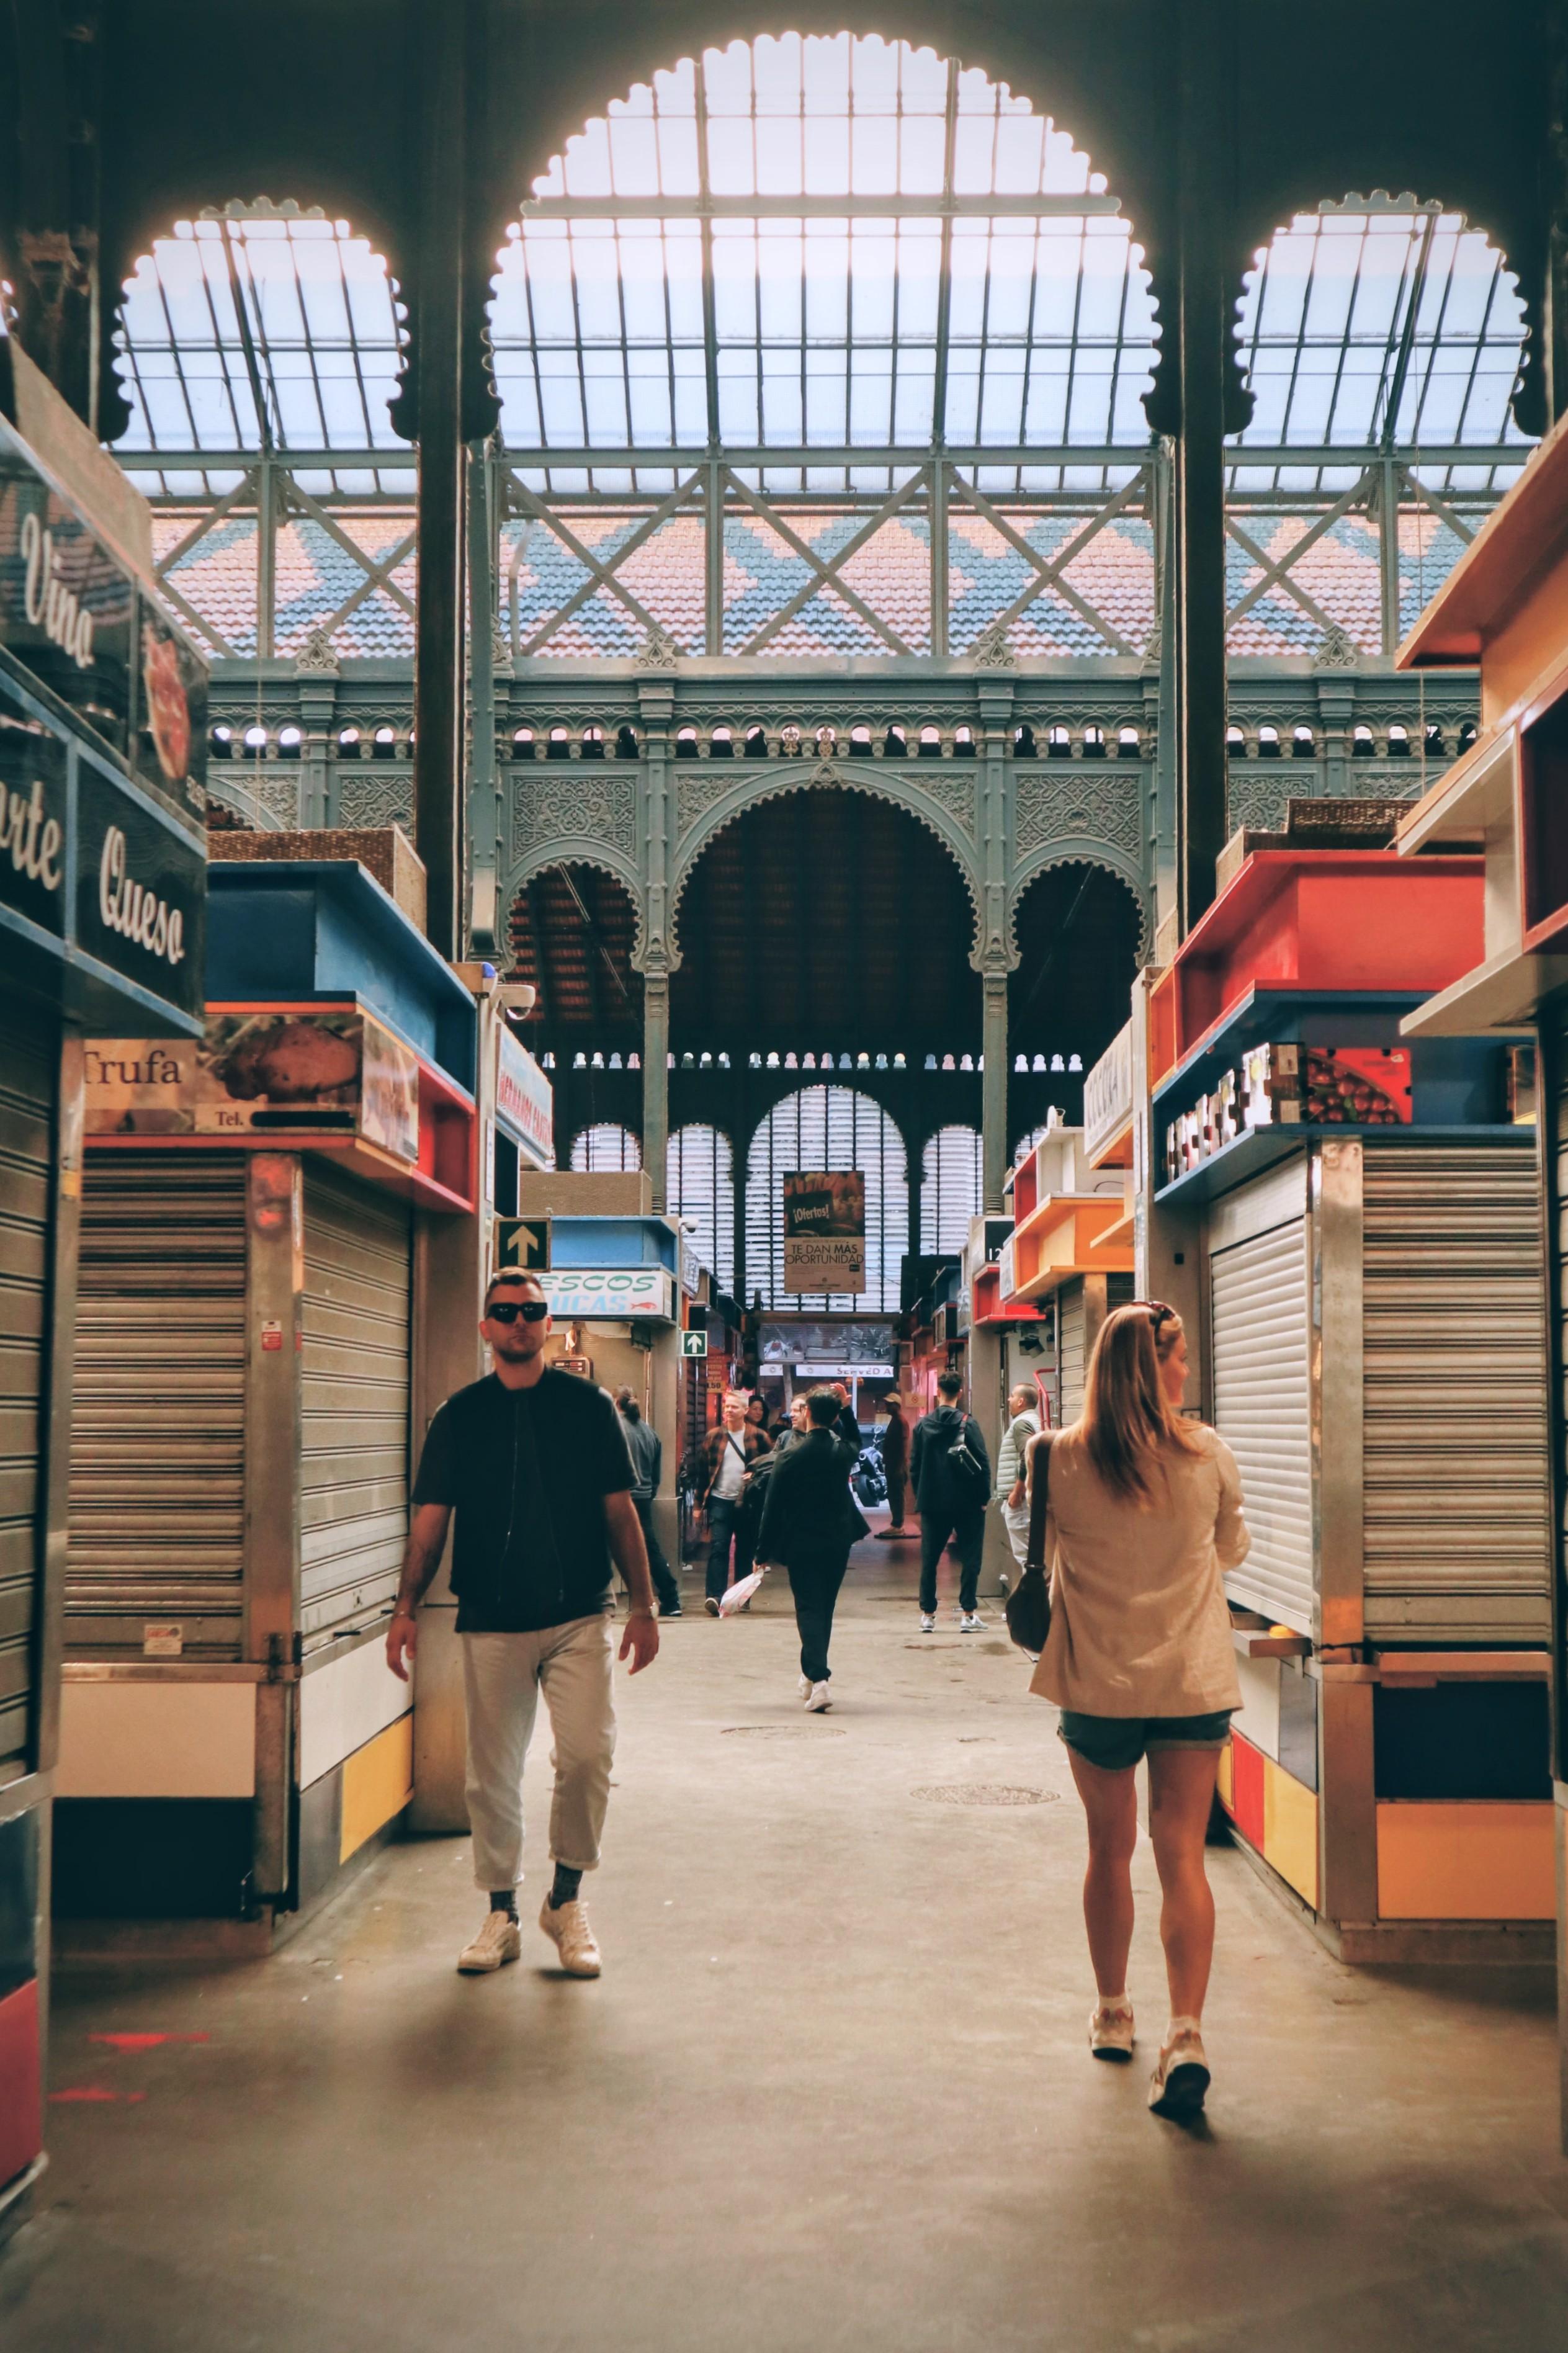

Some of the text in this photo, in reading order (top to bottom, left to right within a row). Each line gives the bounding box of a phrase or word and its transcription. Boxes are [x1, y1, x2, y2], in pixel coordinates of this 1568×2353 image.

[20, 513, 94, 669] Vino
[100, 826, 185, 964] Queso
[215, 1111, 244, 1126] Tel.
[793, 1204, 830, 1224] ¡Ofertas!
[792, 1242, 858, 1254] TE DAN MÁS
[785, 1254, 864, 1265] OPORTUNIDAD
